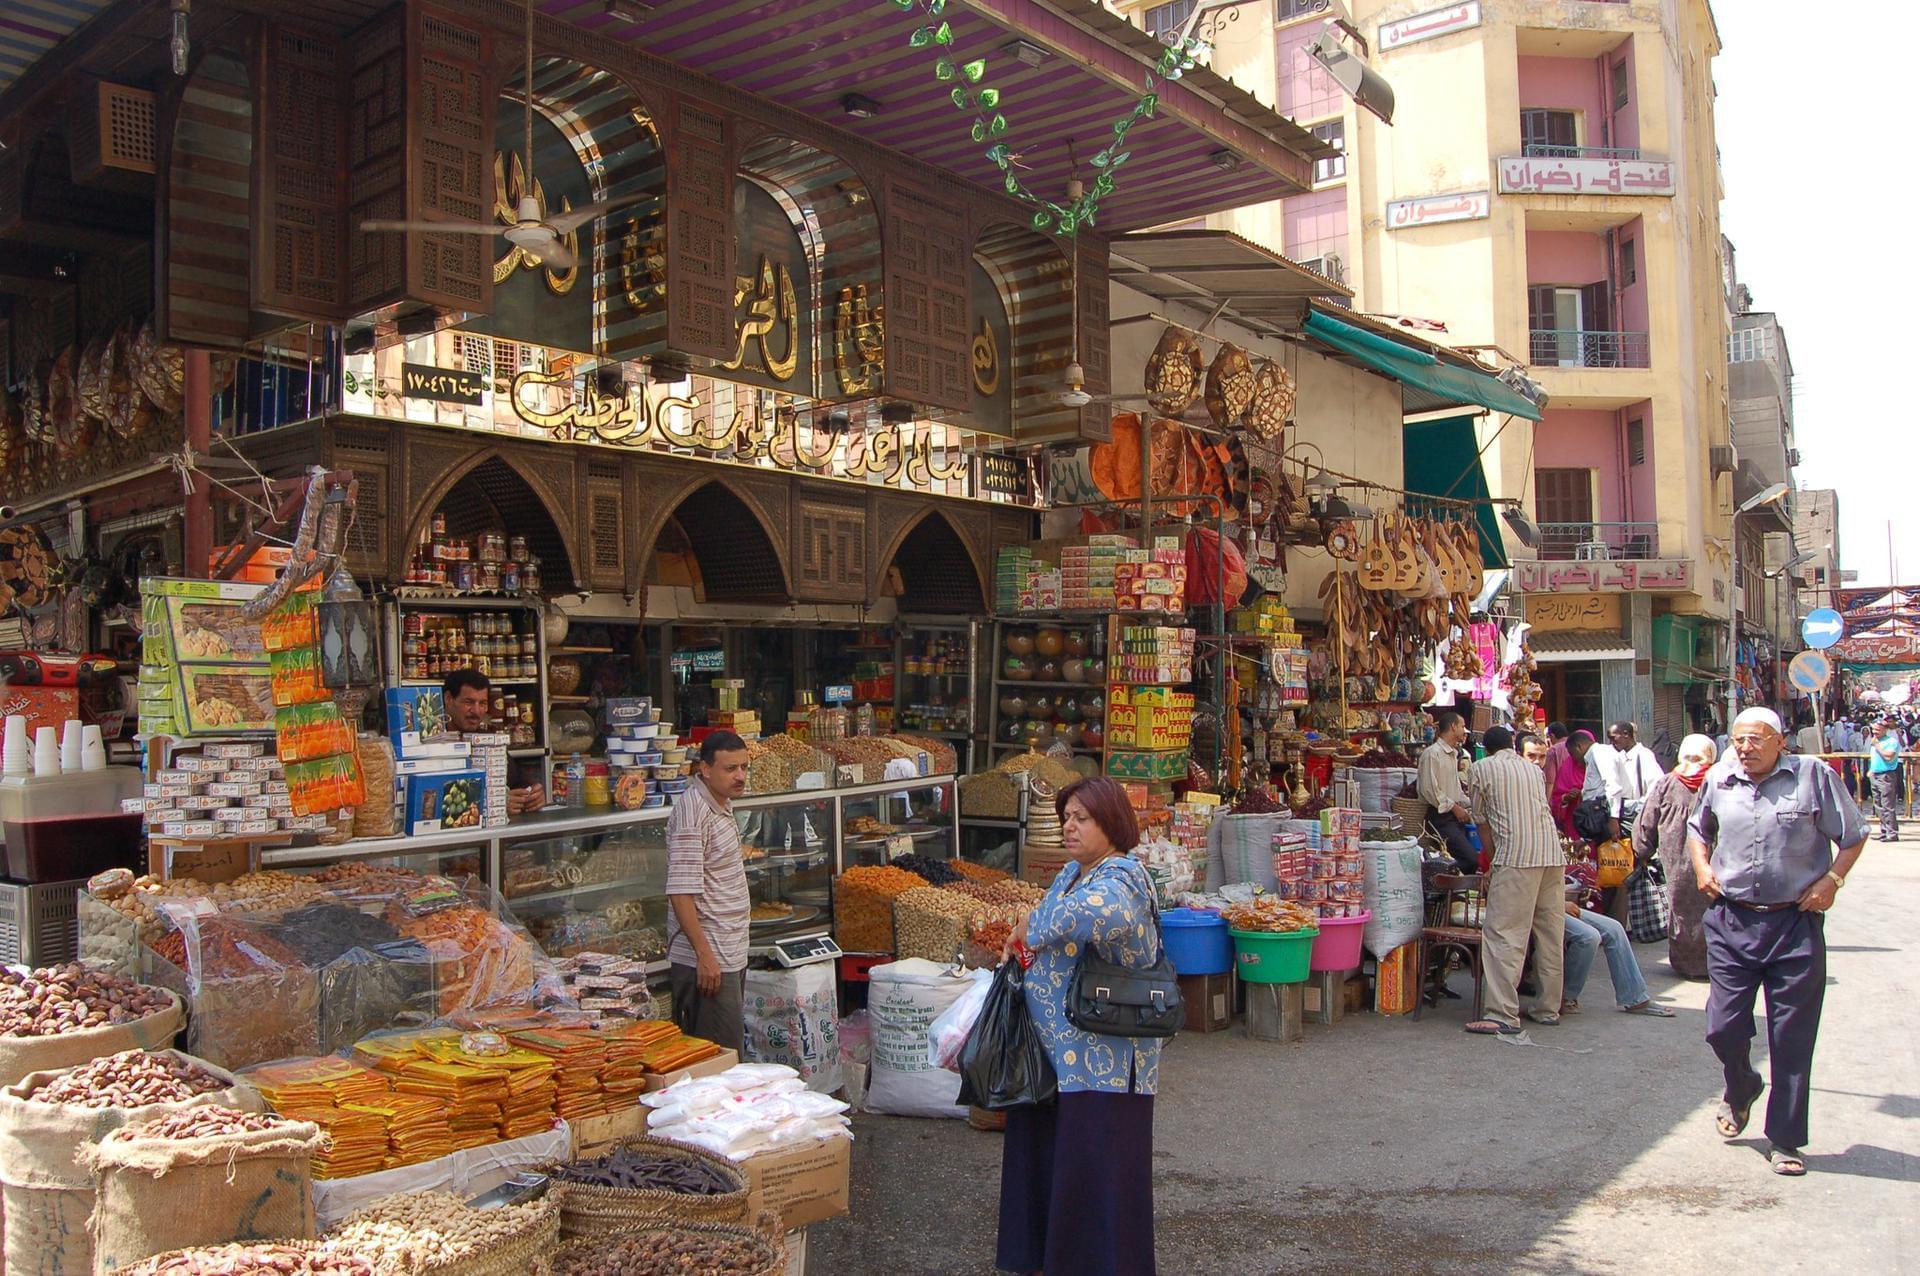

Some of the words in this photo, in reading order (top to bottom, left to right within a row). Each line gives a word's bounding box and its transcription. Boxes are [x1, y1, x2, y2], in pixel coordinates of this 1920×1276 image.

[1389, 6, 1470, 44] فندق
[1505, 161, 1582, 192] رضوان
[1590, 161, 1671, 193] فندق
[1395, 195, 1481, 224] رضوان
[1519, 564, 1600, 591] رضوان
[1603, 561, 1688, 590] فندق
[1376, 854, 1387, 888] VITAL
